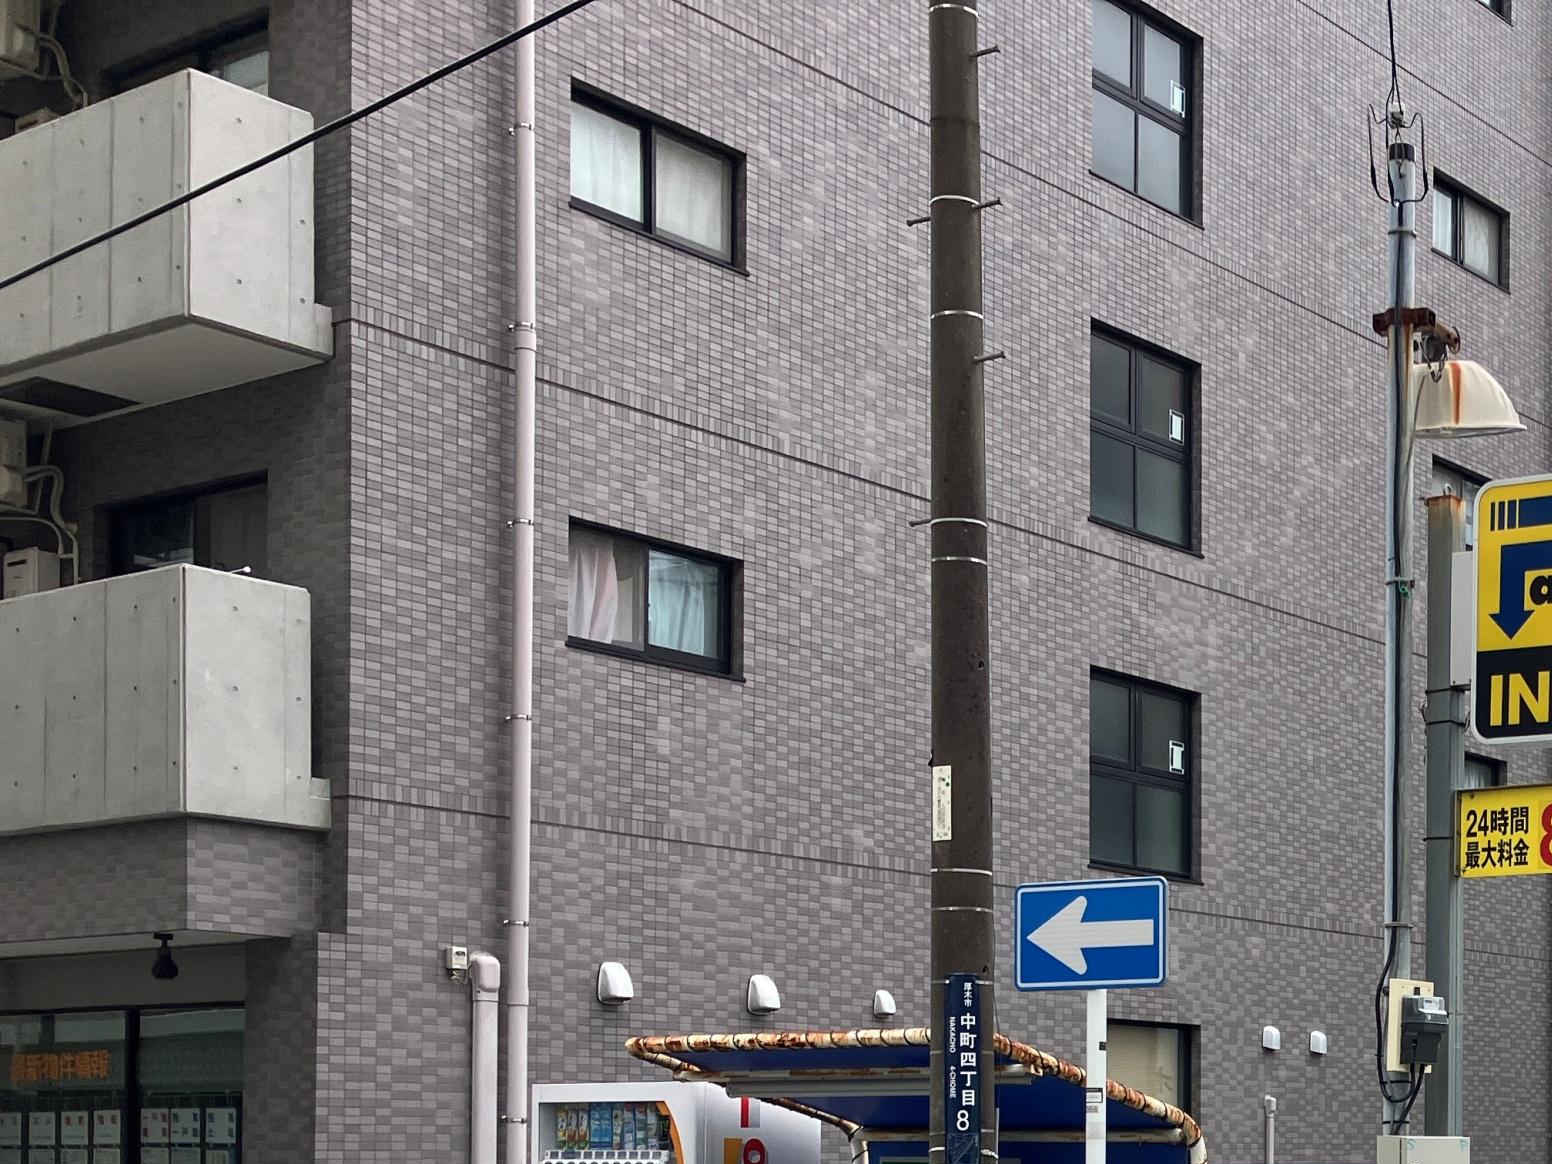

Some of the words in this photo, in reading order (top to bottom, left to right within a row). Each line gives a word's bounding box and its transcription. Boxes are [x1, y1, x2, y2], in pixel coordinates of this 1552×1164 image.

[1489, 671, 1550, 727] IN
[1466, 806, 1530, 838] 24時間
[1465, 838, 1530, 869] 最大料金
[963, 982, 974, 1007] 厚木市
[949, 1016, 957, 1053] NAKACHO
[959, 1012, 977, 1107] 中町四丁目
[949, 1065, 957, 1099] 4-CHOME
[956, 1109, 970, 1132] 8
